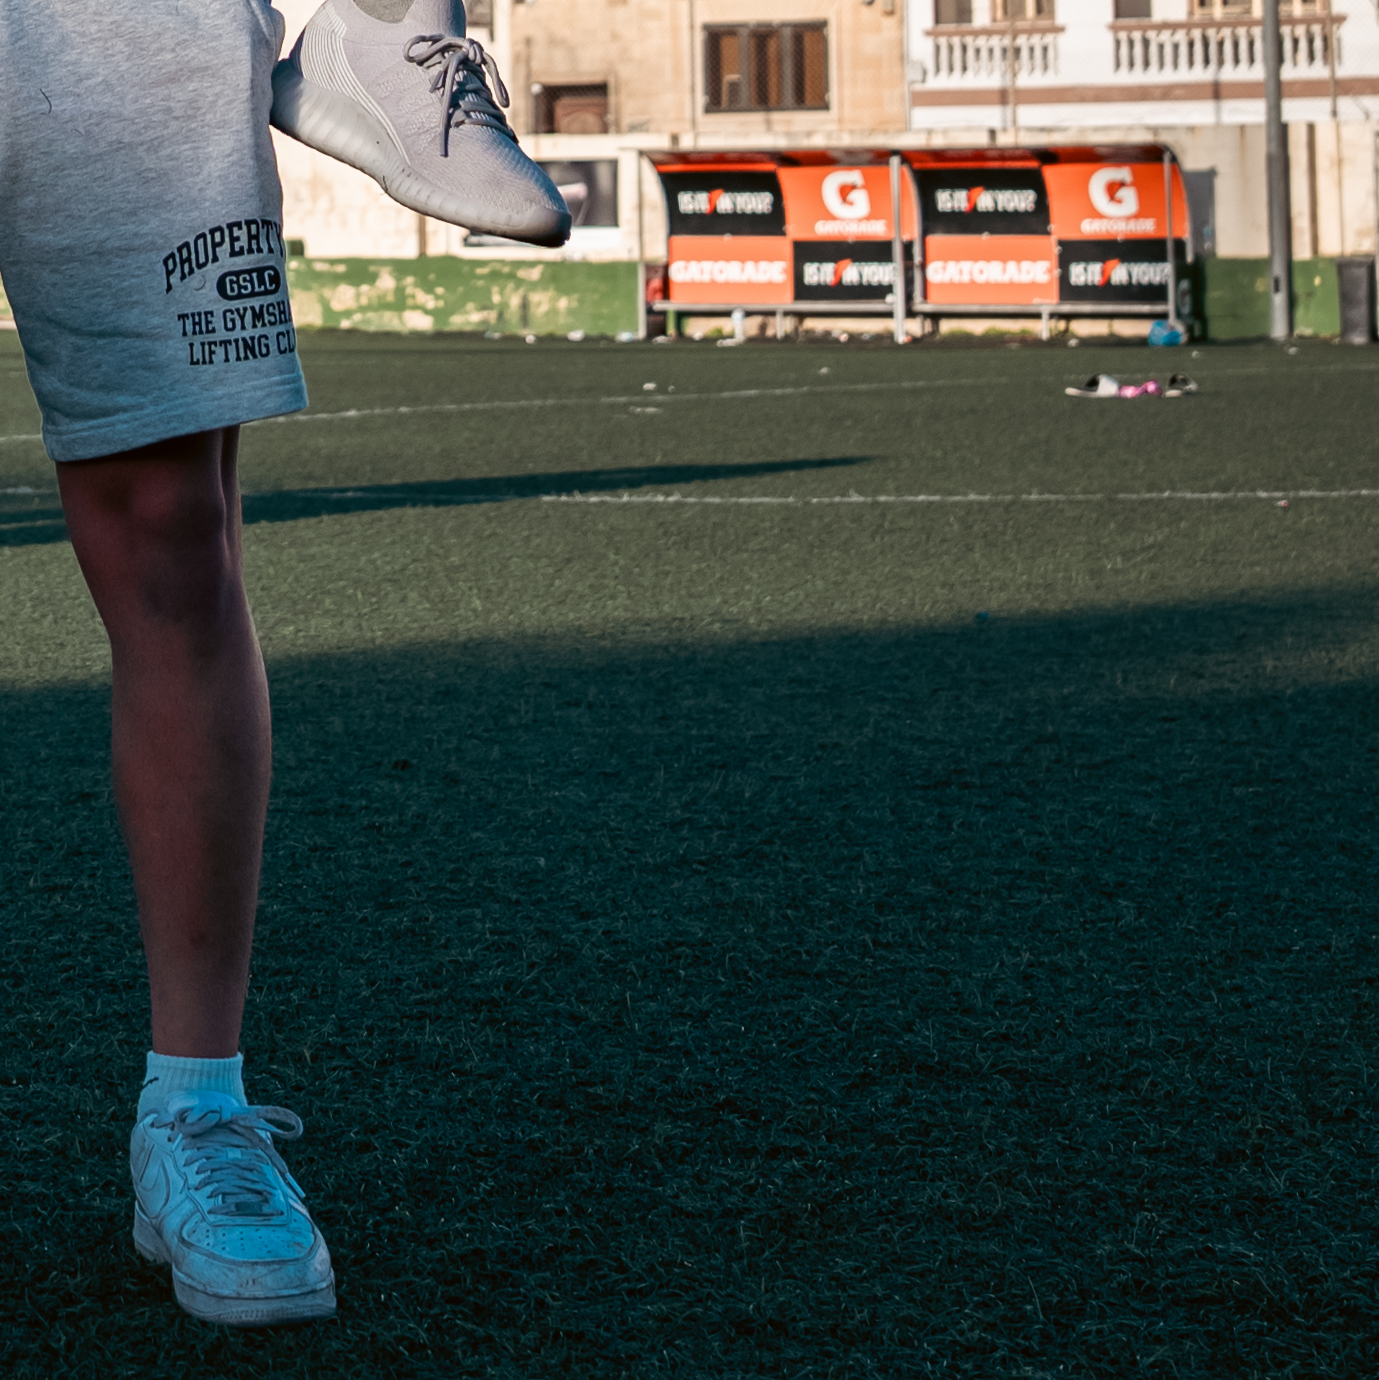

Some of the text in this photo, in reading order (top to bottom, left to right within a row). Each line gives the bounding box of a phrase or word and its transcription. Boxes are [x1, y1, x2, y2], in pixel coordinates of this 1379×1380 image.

[822, 169, 871, 220] G
[1088, 166, 1139, 218] G
[814, 219, 888, 236] GATORADE
[1080, 218, 1156, 234] GATORADE
[162, 218, 284, 295] PROPERTY
[225, 270, 276, 296] GSLC
[670, 260, 788, 283] GATORADE
[926, 260, 1051, 284] GATORADE
[177, 299, 293, 337] THE GYMSH
[188, 334, 270, 366] LIFTING
